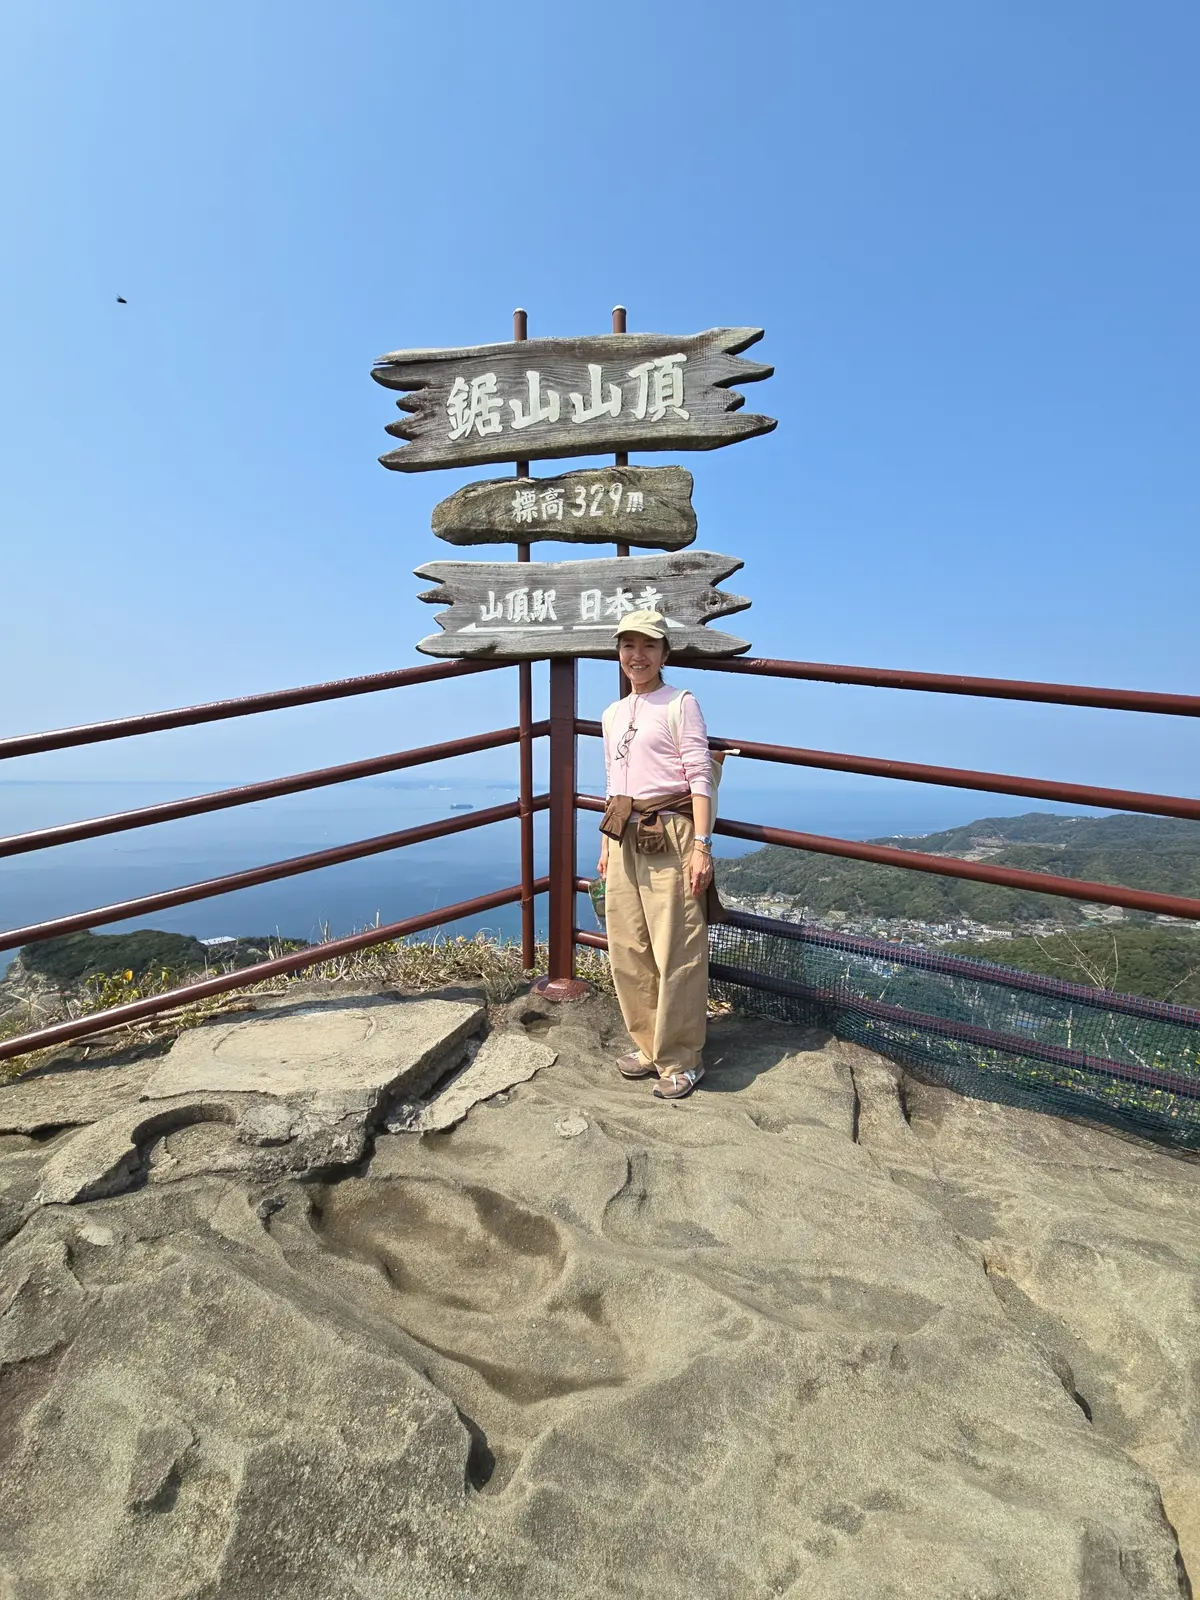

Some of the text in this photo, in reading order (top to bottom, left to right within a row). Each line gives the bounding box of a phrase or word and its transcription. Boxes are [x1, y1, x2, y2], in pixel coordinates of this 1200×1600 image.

[447, 352, 690, 440] 鋸山山頂
[480, 587, 558, 623] 山頂駅
[579, 586, 663, 621] 日本寺
